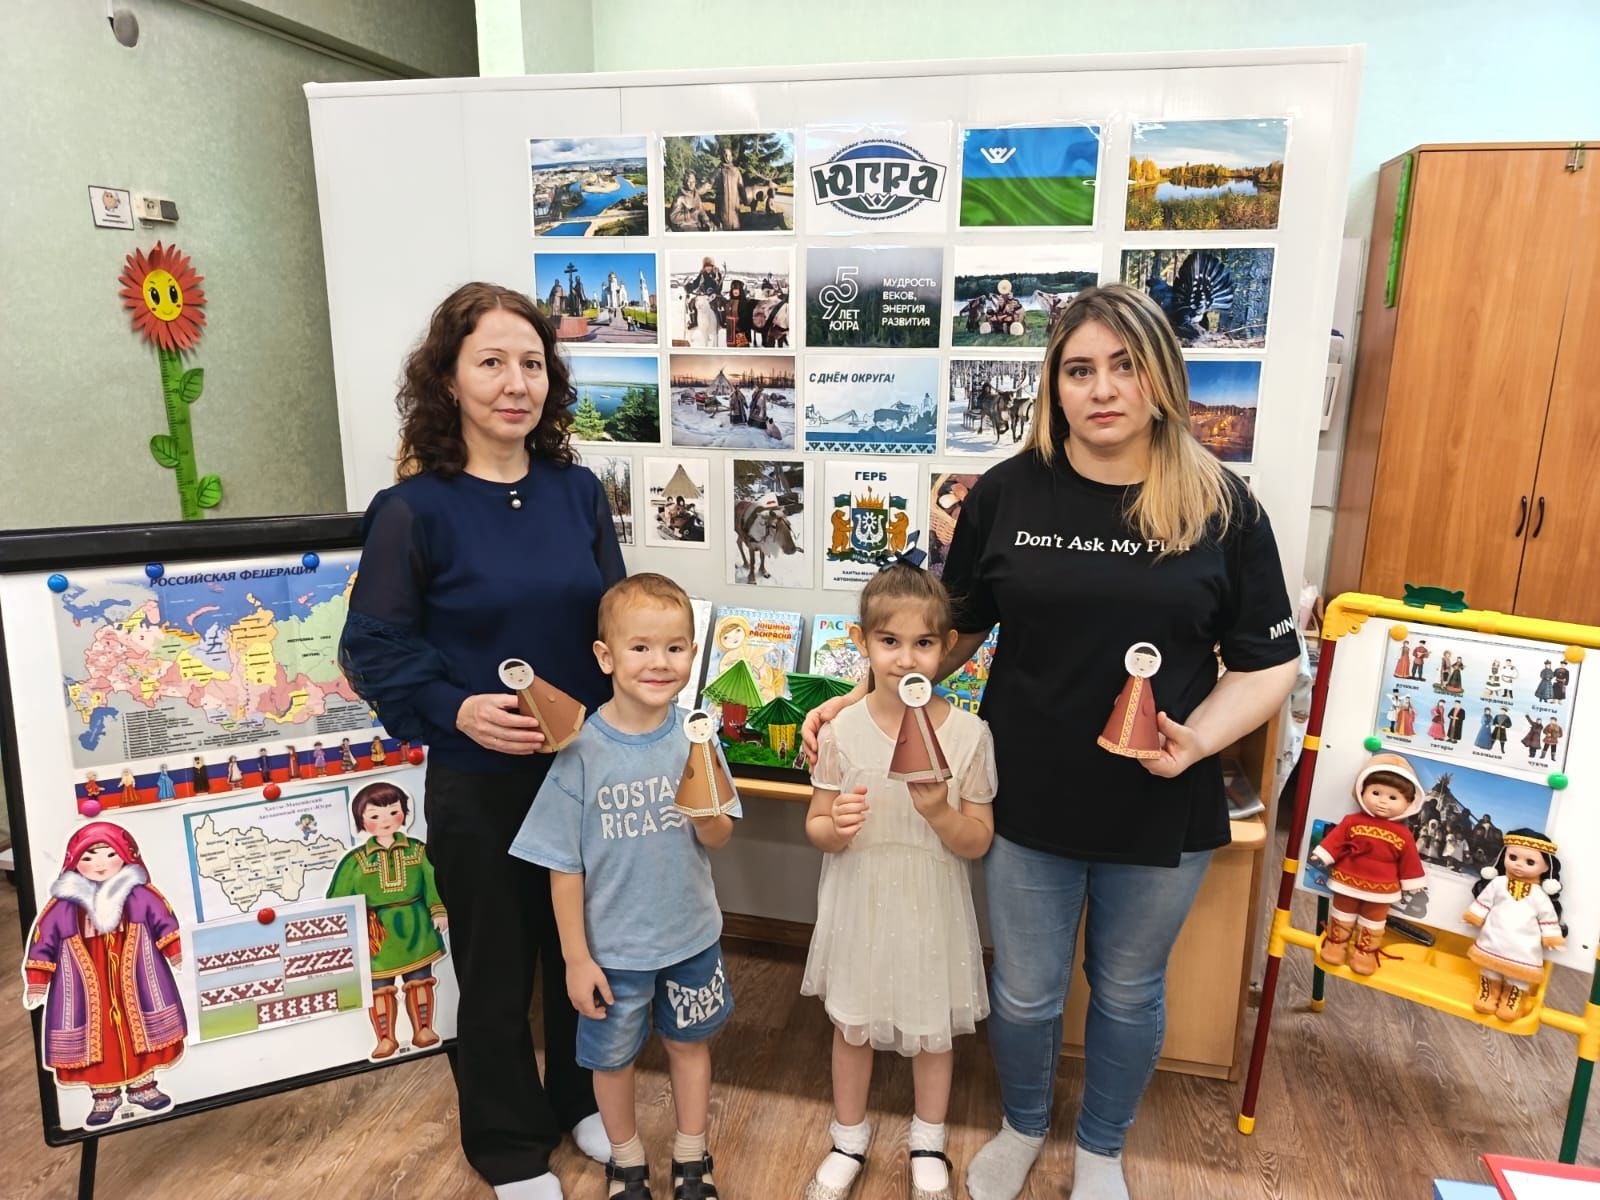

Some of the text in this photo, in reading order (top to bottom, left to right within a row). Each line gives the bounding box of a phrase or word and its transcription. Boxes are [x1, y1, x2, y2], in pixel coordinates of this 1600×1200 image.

[883, 278, 937, 288] МУДРОСТЬ
[883, 291, 917, 301] ВЕКОВ,
[839, 309, 860, 319] ЛЕТ
[882, 304, 926, 314] ЭНЕРГИЯ
[829, 320, 860, 331] ЮГРА
[881, 317, 931, 327] РАЗВИТИЯ
[809, 371, 895, 384] С ДНЁМ ОКРУГА!
[855, 471, 887, 481] ГЕРБ
[1014, 530, 1064, 548] Don't
[1067, 535, 1105, 552] Ask
[1110, 539, 1142, 556] My
[150, 566, 317, 588] РОССИЙСКАЯ ФЕДЕРАЦИЯ
[597, 775, 676, 810] COSTA
